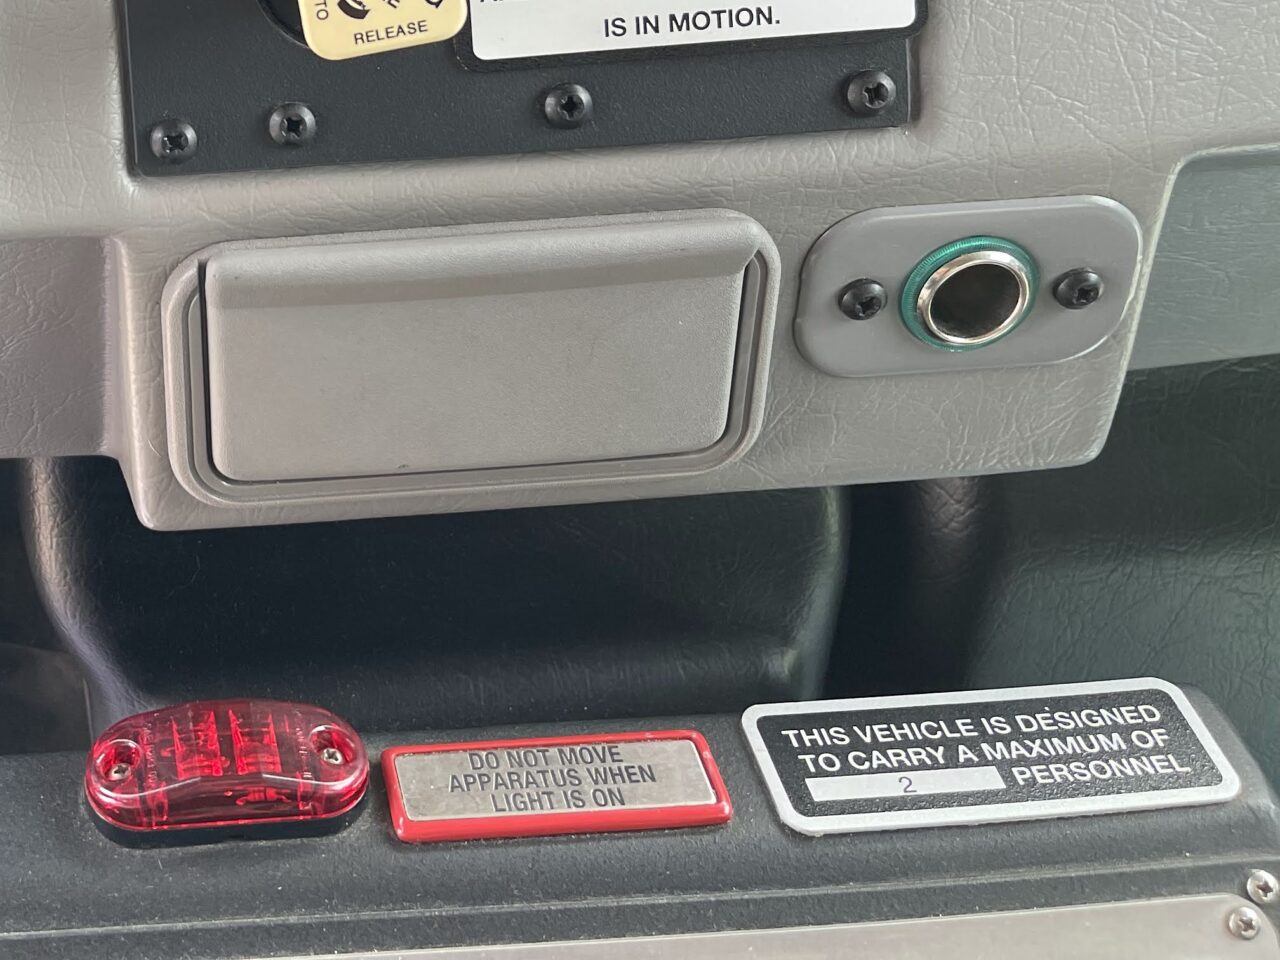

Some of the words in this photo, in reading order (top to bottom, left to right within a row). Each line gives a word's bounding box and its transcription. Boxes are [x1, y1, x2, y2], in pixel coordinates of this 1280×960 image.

[314, 0, 329, 21] TO
[353, 19, 429, 45] RELEASE
[604, 17, 627, 38] IS
[635, 14, 660, 35] IN
[668, 5, 780, 32] MOTION.
[781, 726, 858, 750] THIS
[852, 718, 980, 745] VEHICLE
[980, 715, 1012, 735] IS
[1016, 704, 1162, 733] DESIGNED
[469, 751, 498, 771] DO
[508, 748, 551, 769] NOT
[558, 744, 624, 766] MOVE
[798, 752, 841, 774] TO
[846, 746, 946, 770] CARRY
[956, 744, 979, 763] A
[980, 732, 1127, 761] MAXIMUM
[1130, 728, 1172, 748] OF
[447, 768, 582, 793] APPARATUS
[587, 764, 657, 786] WHEN
[897, 775, 918, 794] 2
[1010, 753, 1192, 786] PERSONNEL
[490, 790, 556, 813] LIGHT
[562, 788, 587, 809] IS
[591, 787, 627, 808] ON
